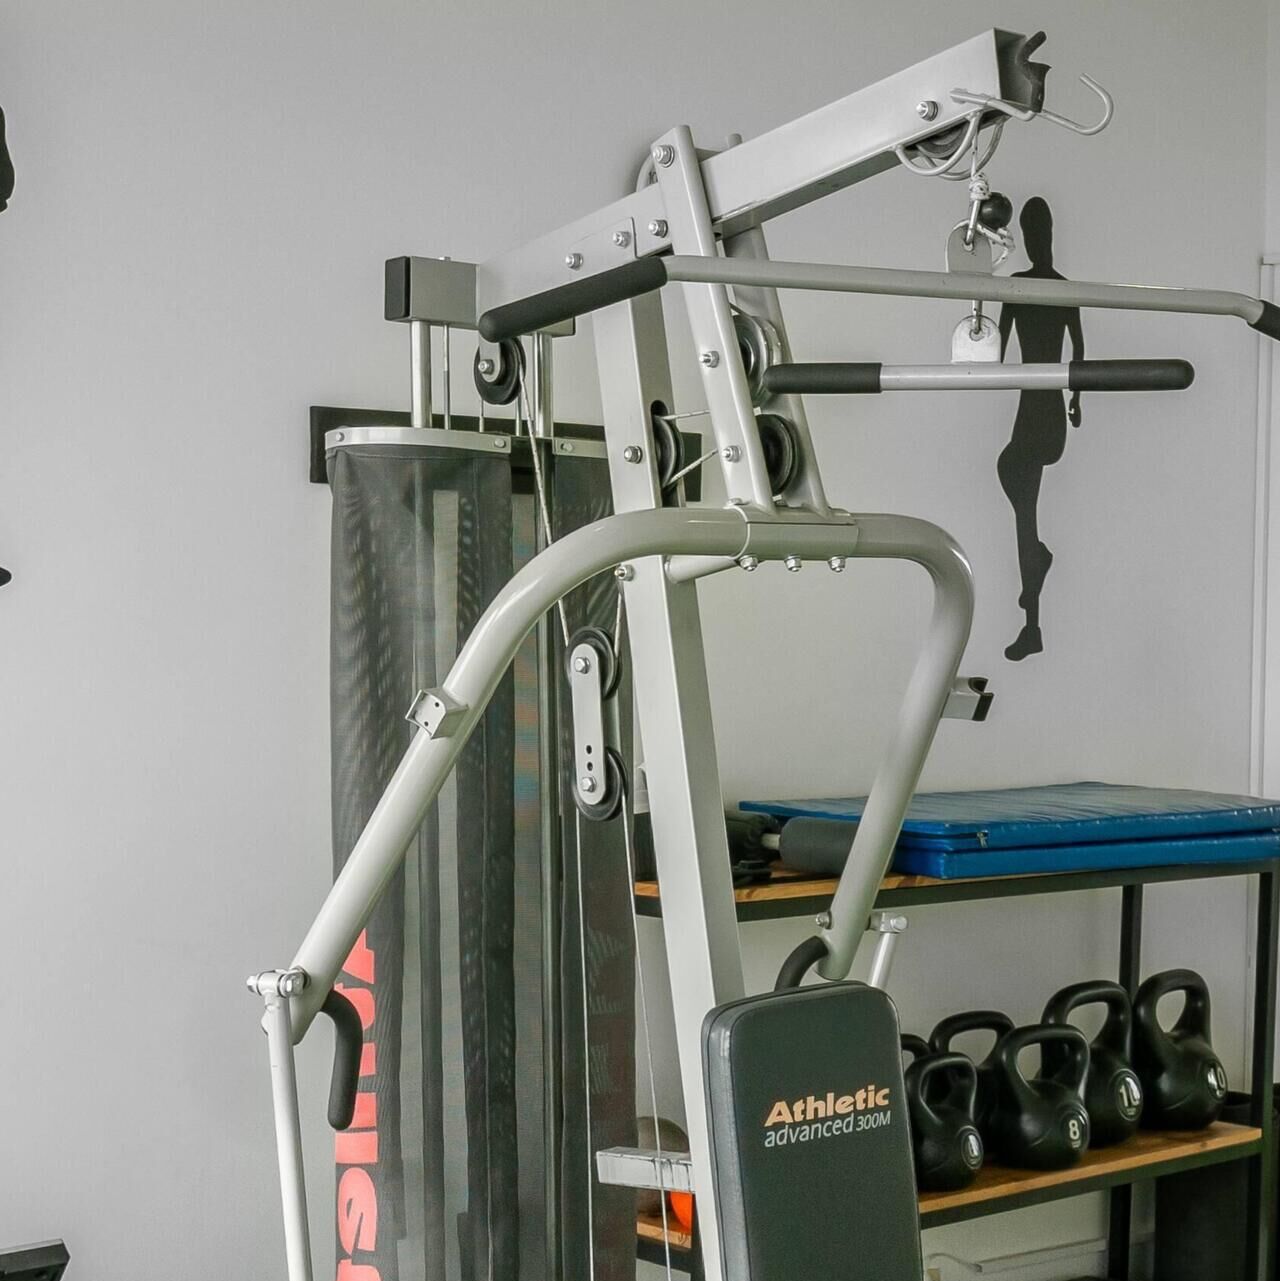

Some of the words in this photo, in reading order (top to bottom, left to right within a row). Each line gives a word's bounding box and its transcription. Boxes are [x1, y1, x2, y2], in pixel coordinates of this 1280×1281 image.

[764, 1085, 890, 1127] Athletic
[764, 1112, 855, 1148] advanced
[856, 1110, 891, 1132] 300M
[1068, 1119, 1080, 1140] 8
